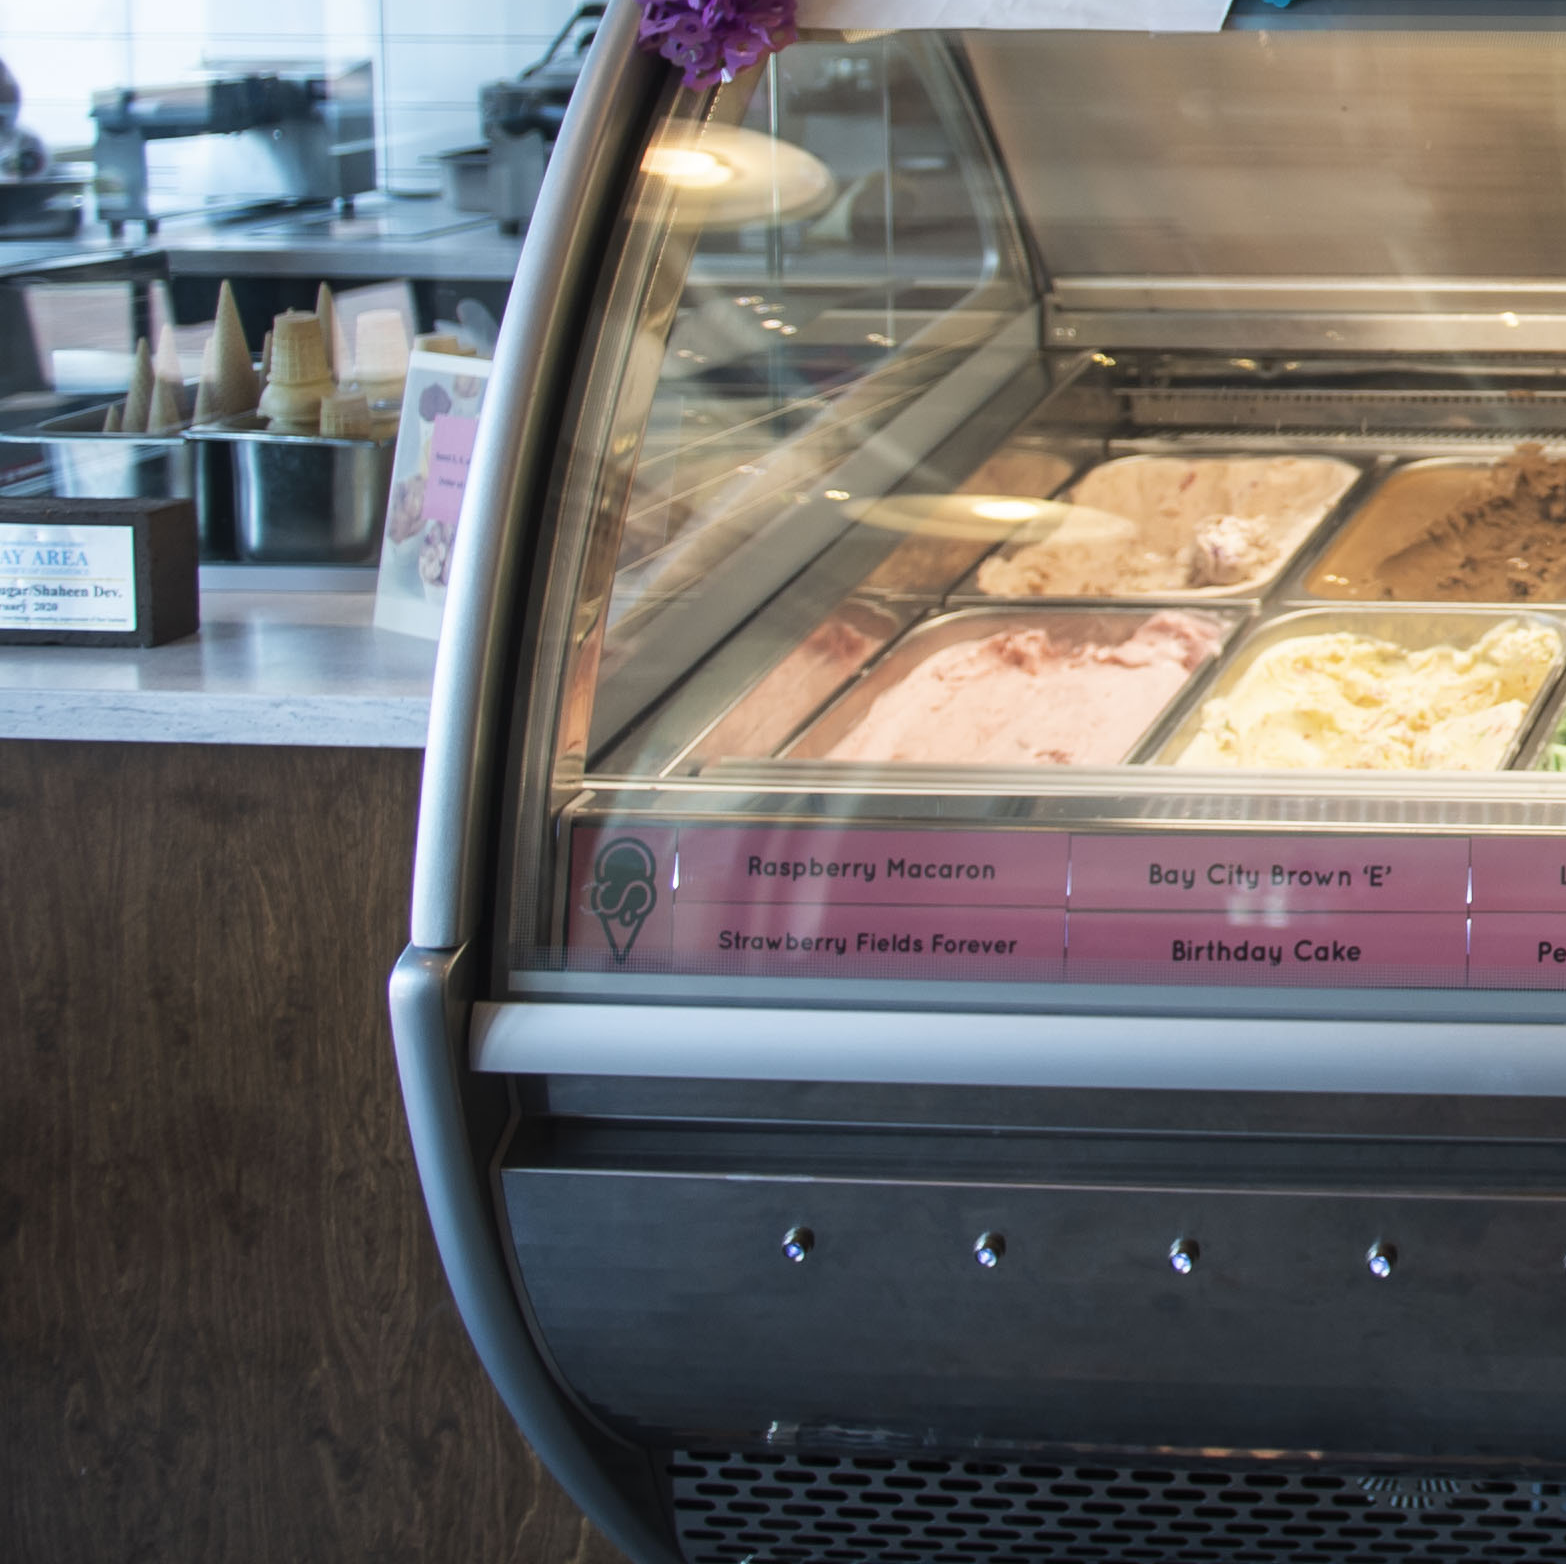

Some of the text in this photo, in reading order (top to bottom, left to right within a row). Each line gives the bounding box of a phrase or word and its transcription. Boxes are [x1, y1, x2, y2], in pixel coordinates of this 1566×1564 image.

[0, 549, 88, 566] AY AREA
[0, 584, 122, 597] ugar/Shaheen Dev.
[748, 856, 995, 882] Raspberry Macaron
[1149, 863, 1391, 890] Bay City Brown ‘E’
[719, 930, 1017, 956] Strawberry Fields Forever
[1172, 940, 1361, 966] Birthday Cake
